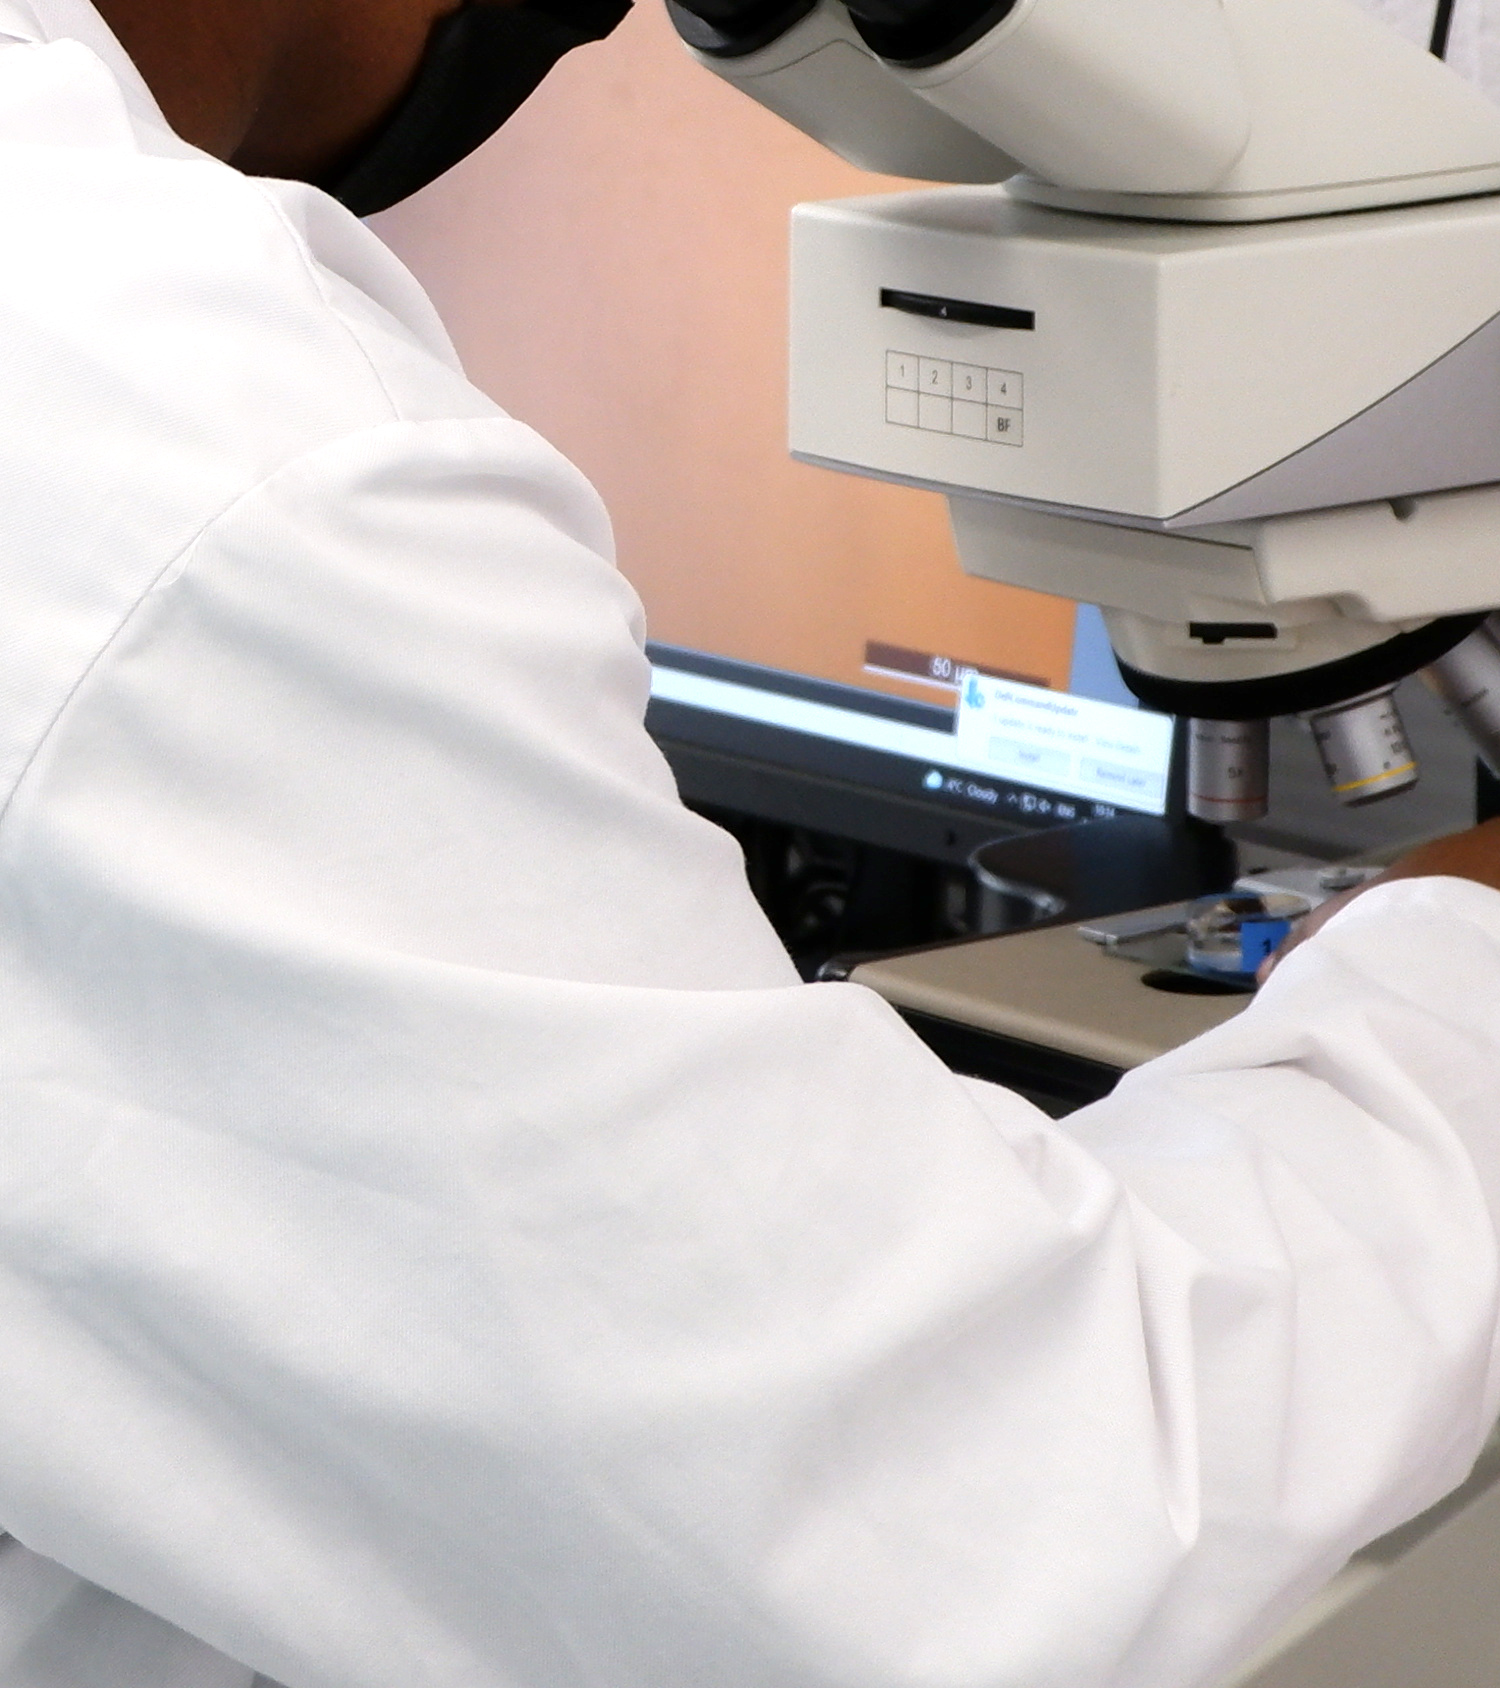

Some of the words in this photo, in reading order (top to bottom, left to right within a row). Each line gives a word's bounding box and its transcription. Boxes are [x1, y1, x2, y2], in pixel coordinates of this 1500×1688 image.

[931, 369, 938, 385] 2
[965, 375, 973, 390] 3
[1000, 382, 1007, 396] 4
[997, 416, 1011, 433] BF
